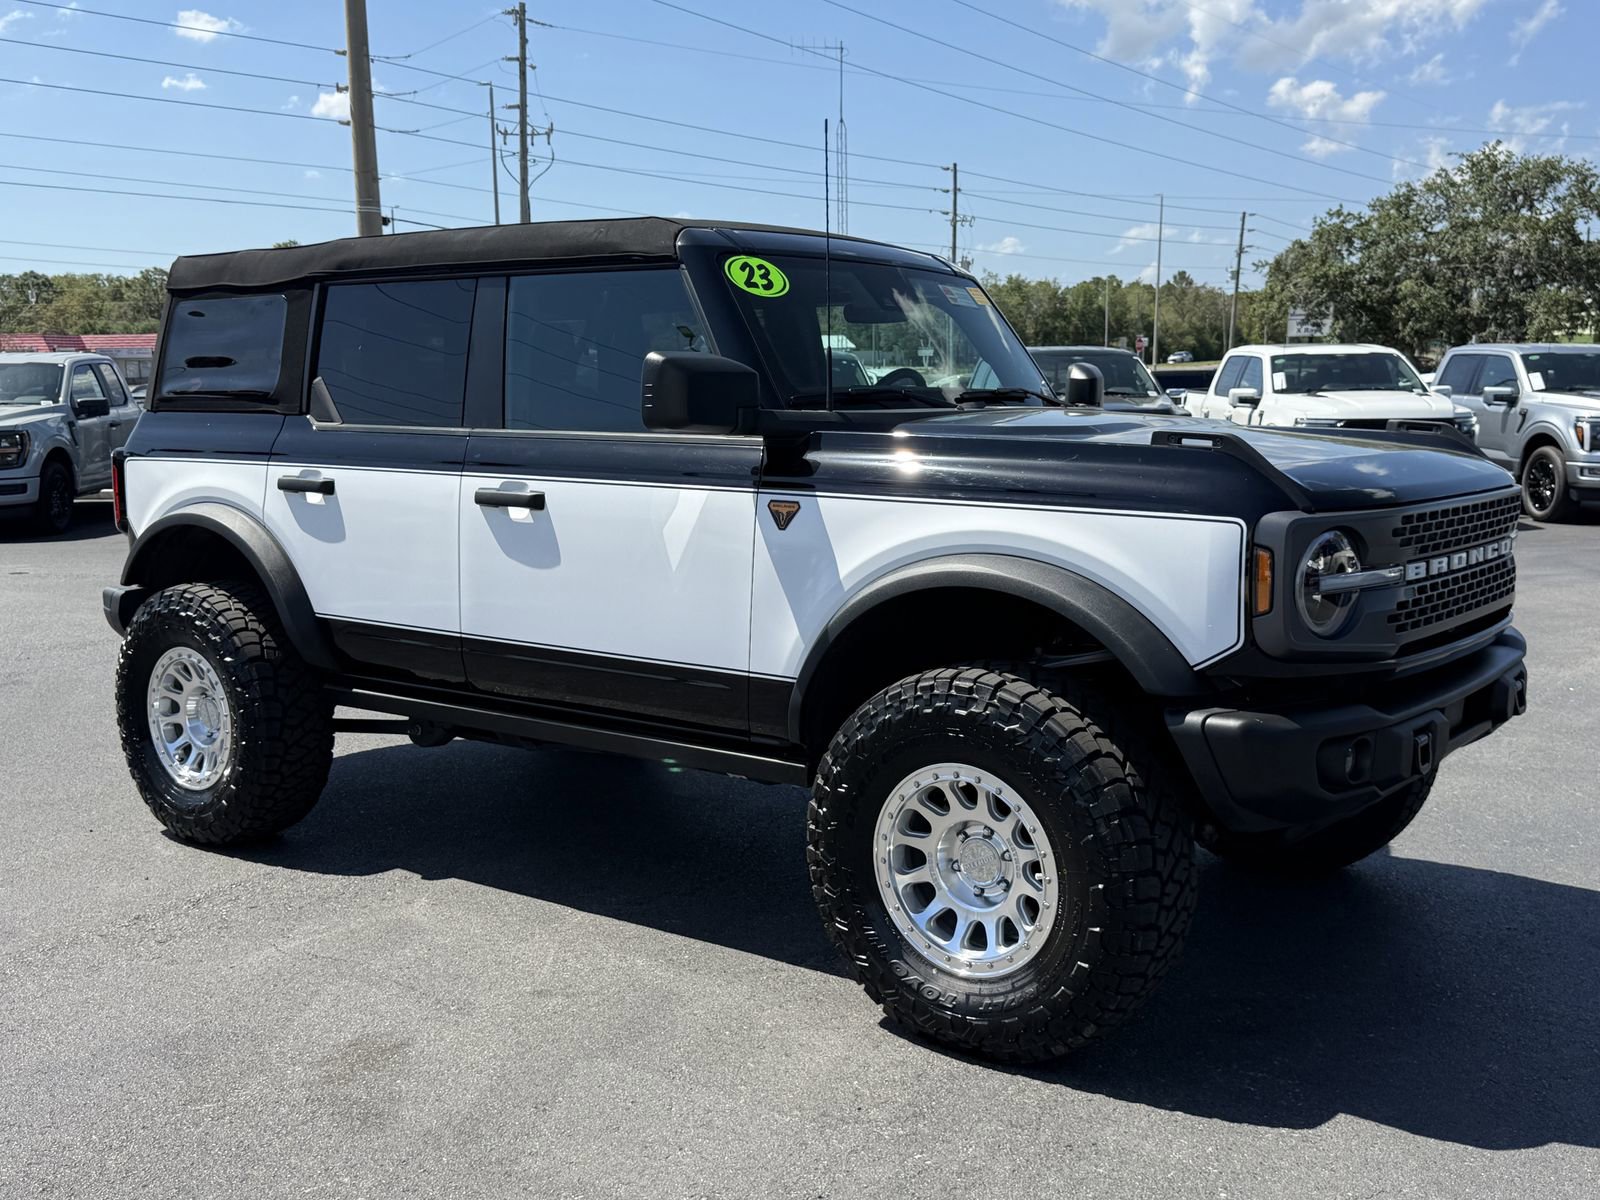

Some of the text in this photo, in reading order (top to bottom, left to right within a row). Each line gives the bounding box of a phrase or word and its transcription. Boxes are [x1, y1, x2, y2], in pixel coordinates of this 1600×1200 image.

[739, 261, 775, 291] 23
[1405, 538, 1513, 580] BRONCO
[963, 855, 994, 872] METHOD
[888, 959, 957, 1008] TOYO
